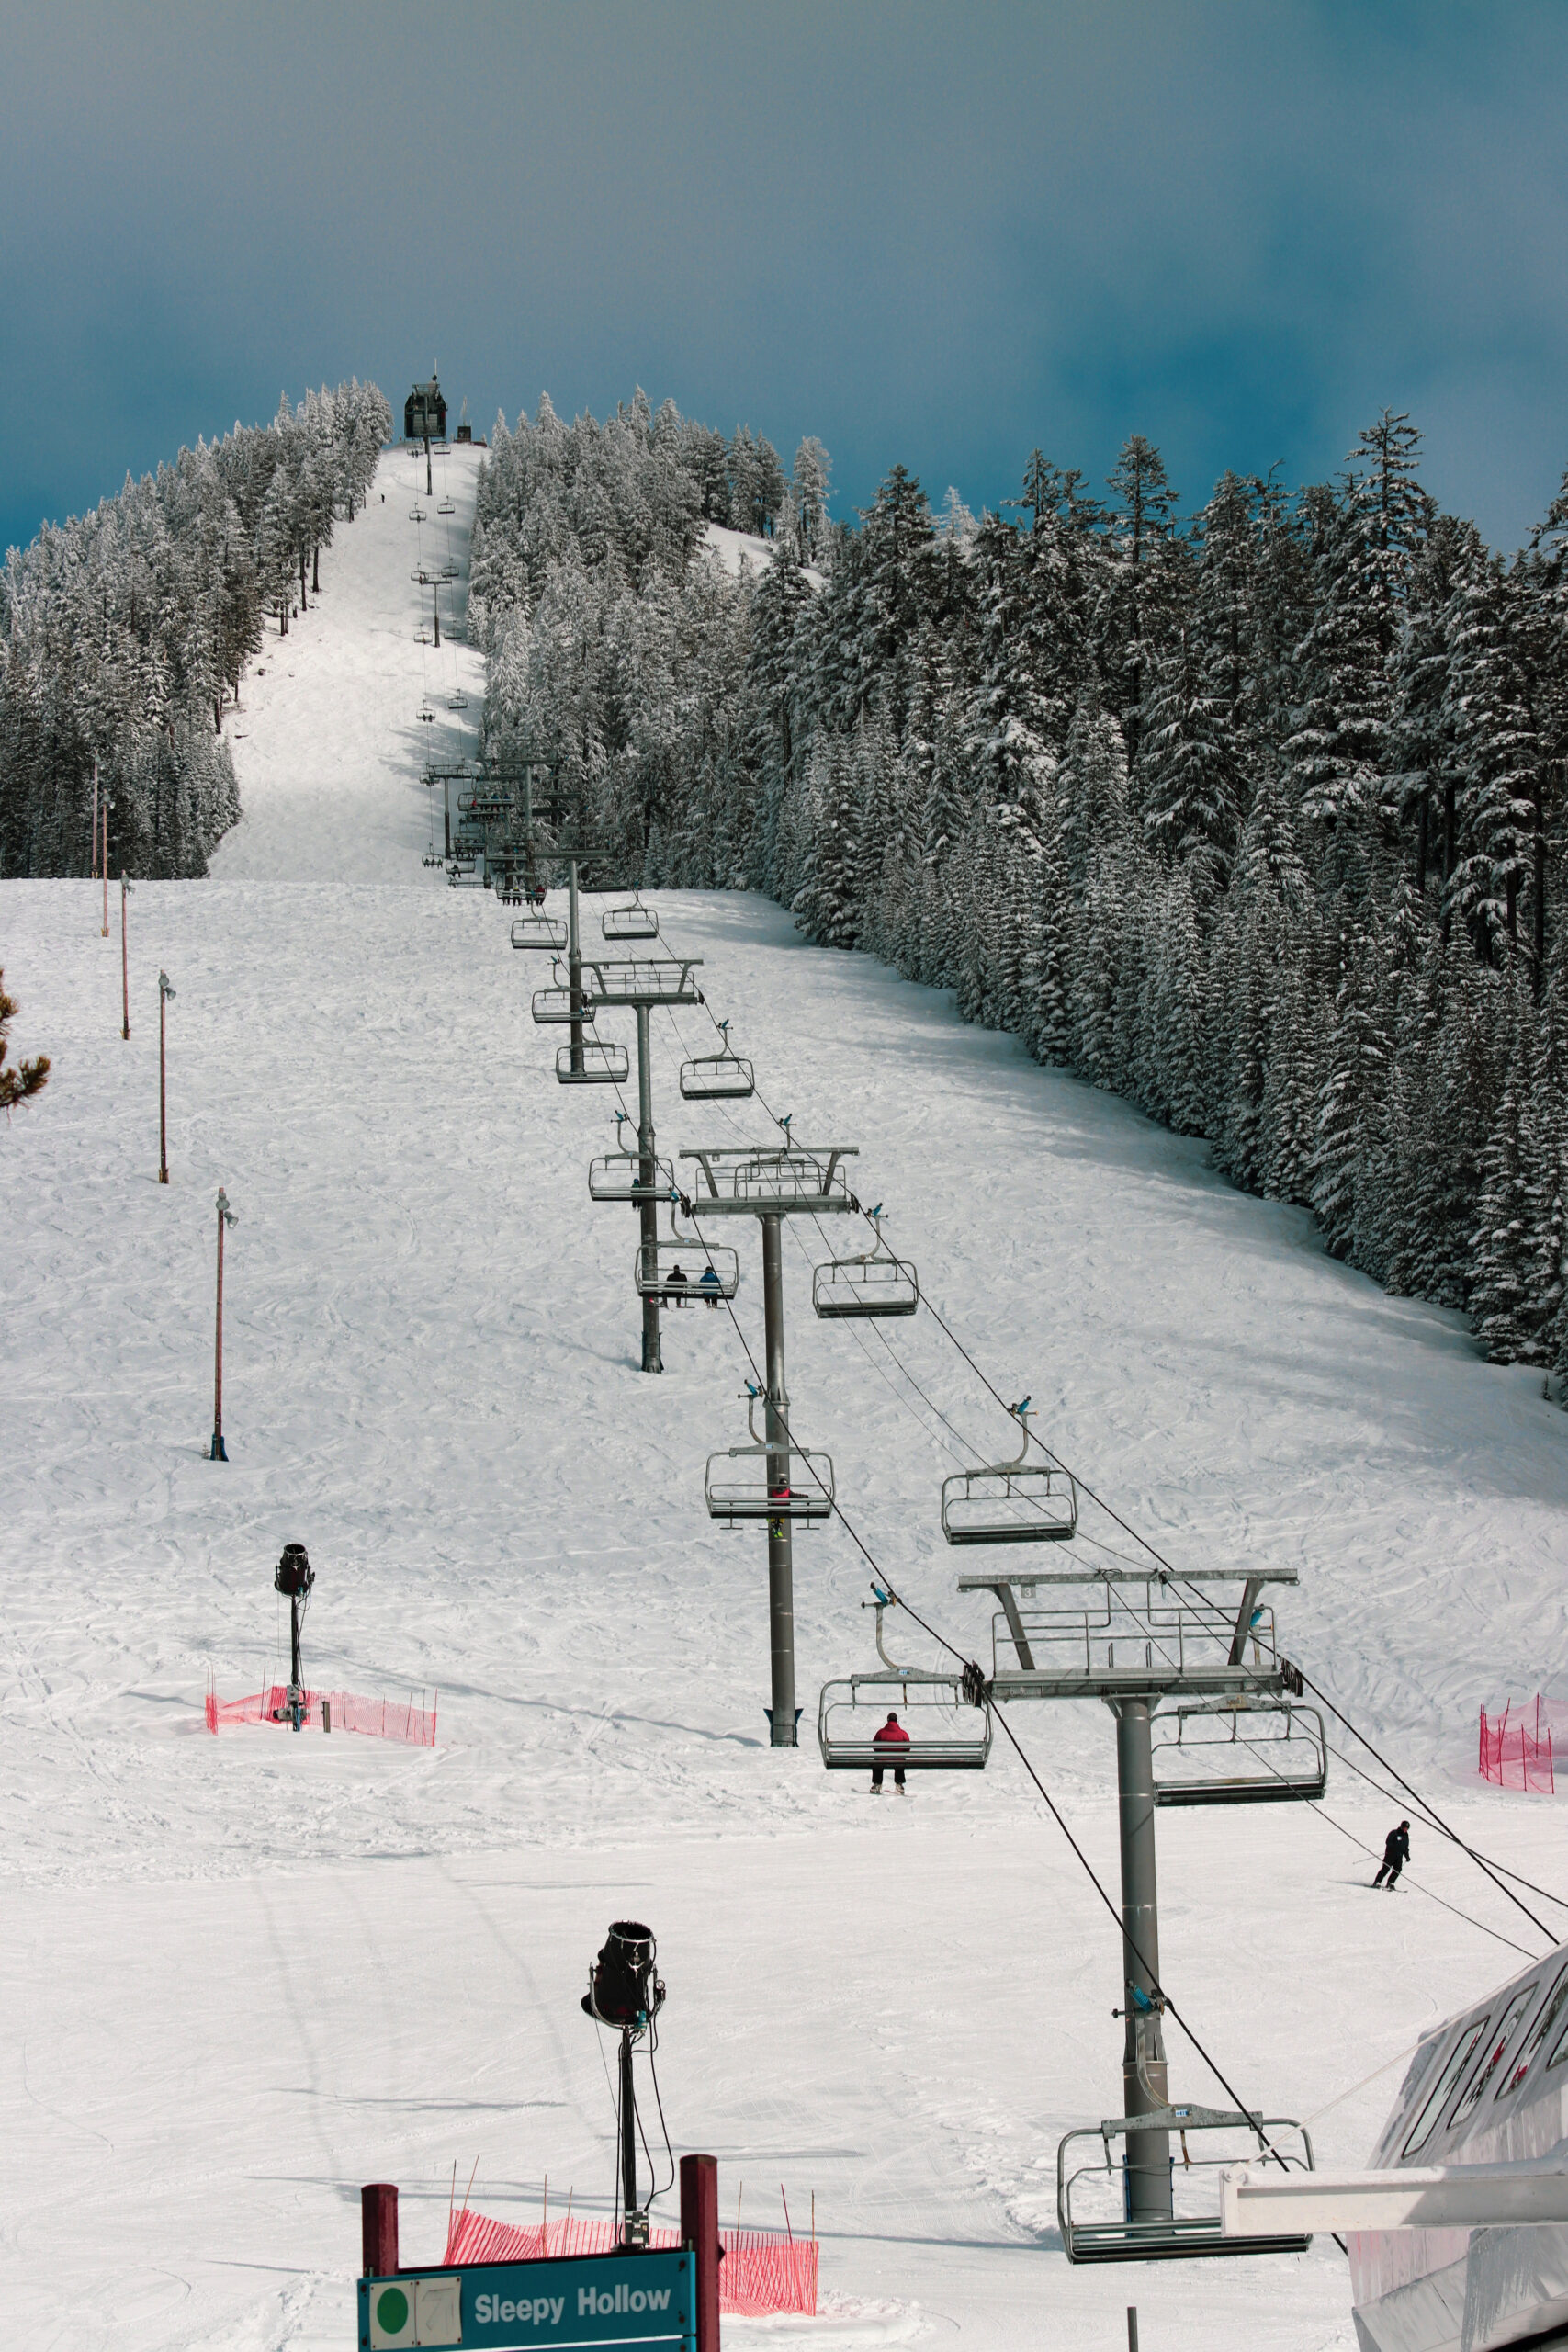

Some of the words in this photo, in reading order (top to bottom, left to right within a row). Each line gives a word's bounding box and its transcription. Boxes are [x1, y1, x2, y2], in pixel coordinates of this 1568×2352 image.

[1024, 1587, 1032, 1598] 3
[475, 2293, 565, 2326] Sleepy
[578, 2284, 671, 2316] Hollow
